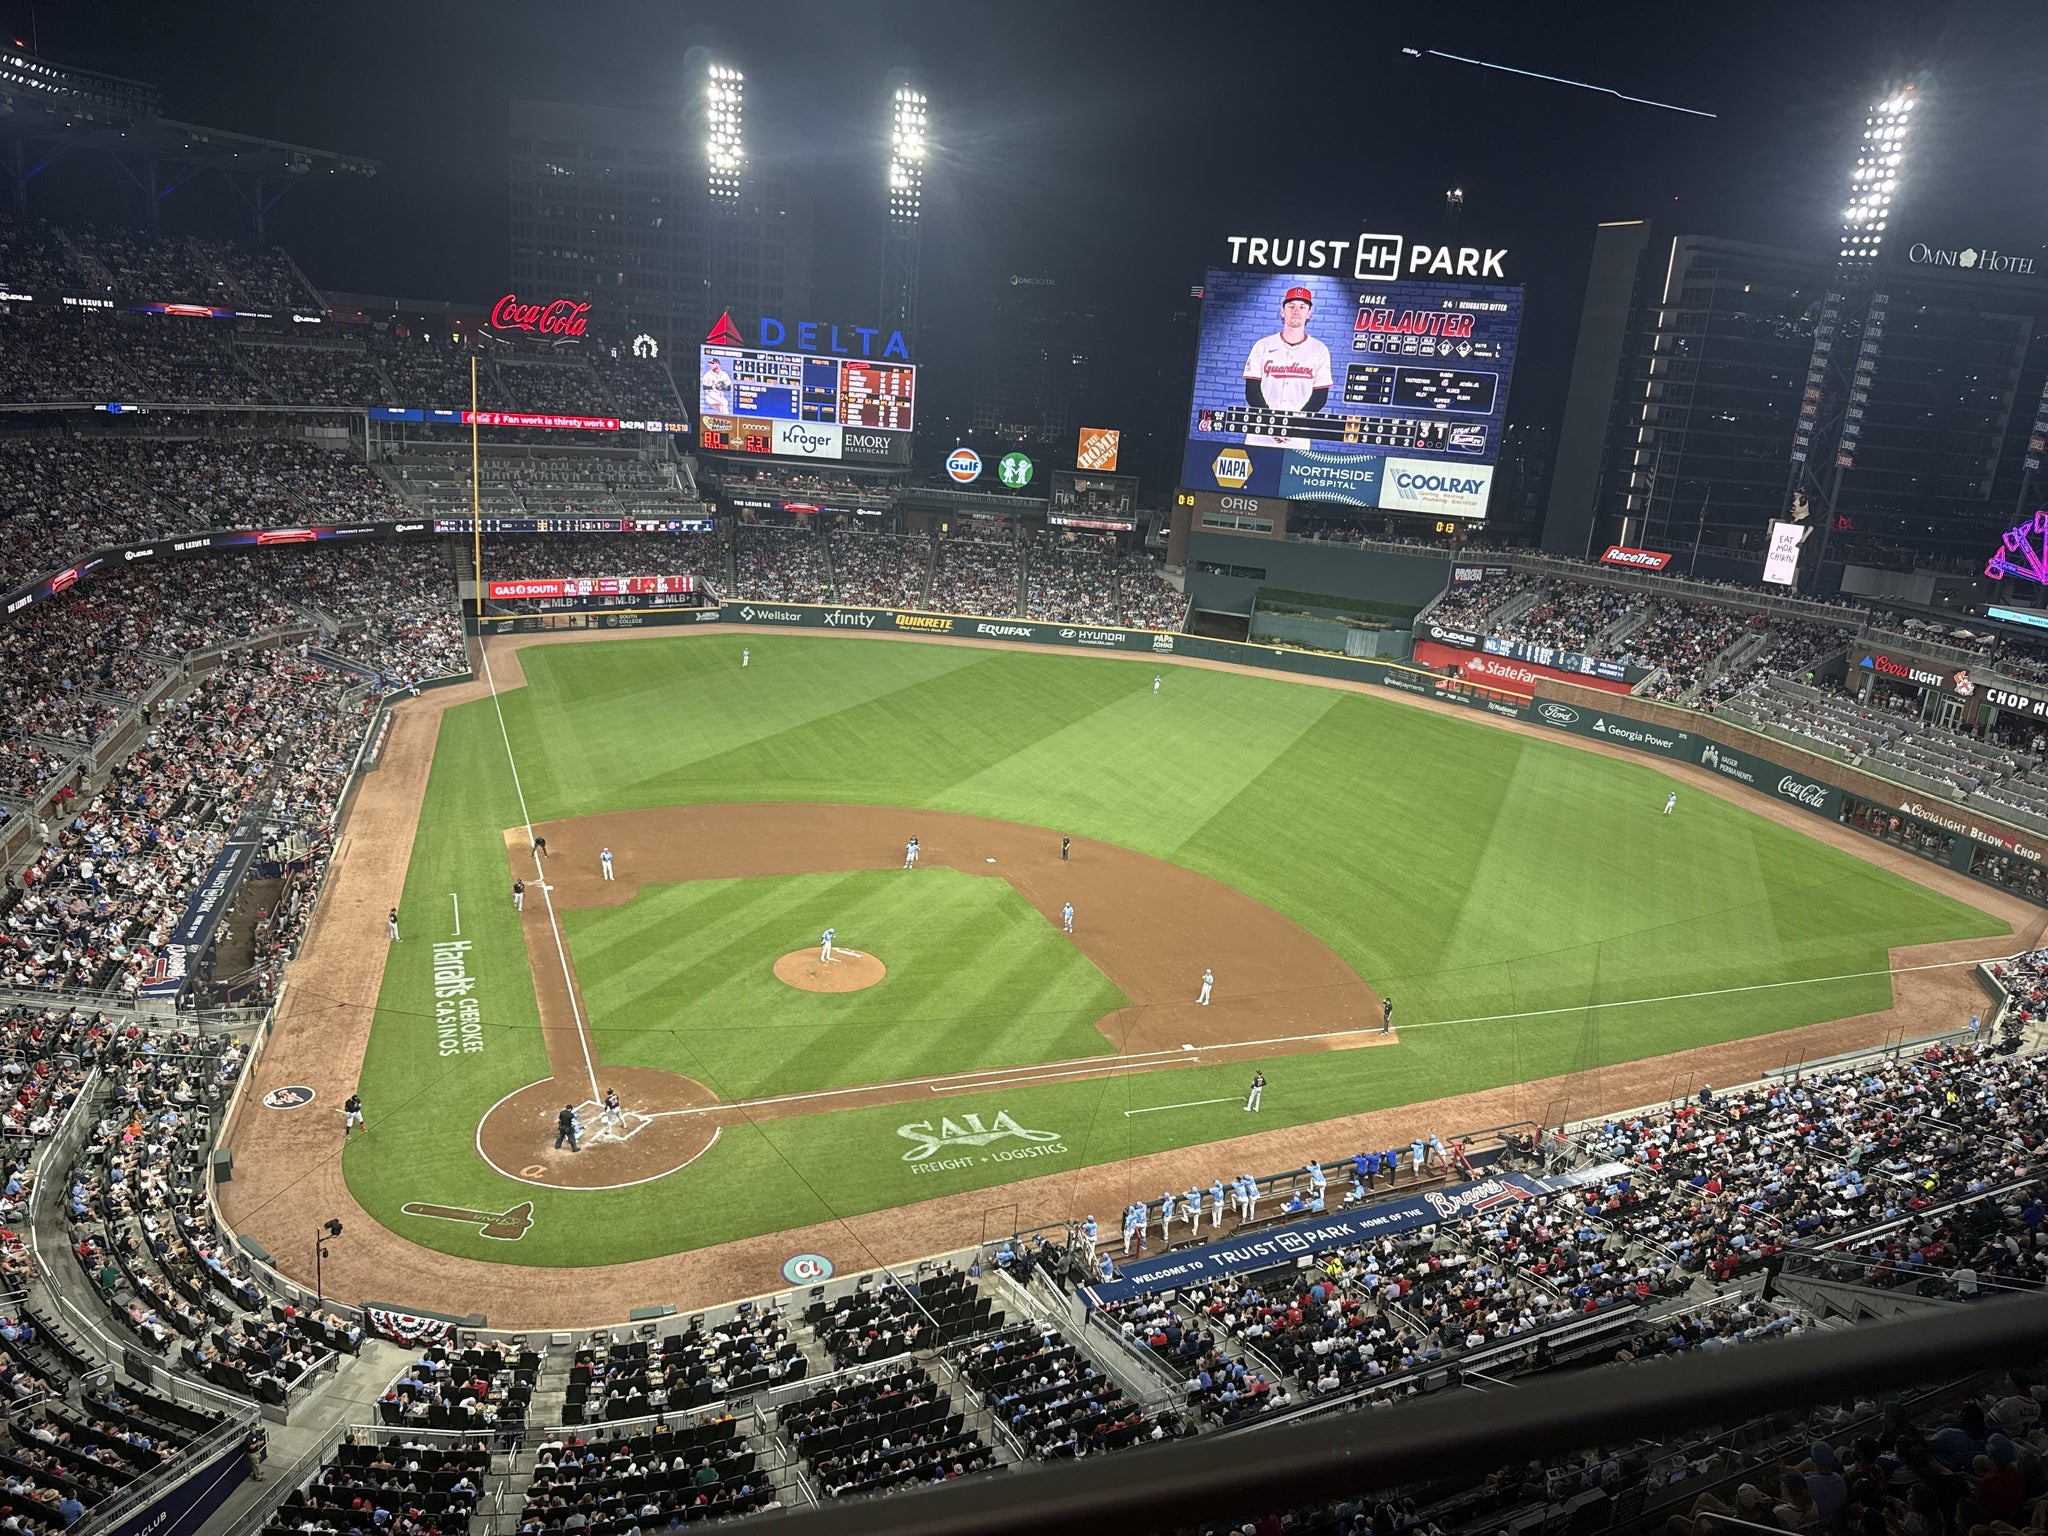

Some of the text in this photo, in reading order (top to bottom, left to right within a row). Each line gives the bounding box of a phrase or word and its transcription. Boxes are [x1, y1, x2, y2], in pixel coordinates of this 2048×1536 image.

[1227, 236, 1509, 278] TRUIST PARK
[63, 297, 78, 305] THE
[79, 298, 102, 307] LEXUS
[1359, 295, 1387, 305] CHASE
[1443, 301, 1453, 309] 24
[491, 294, 593, 337] Coca-Cola
[1354, 308, 1476, 338] DELAUTER
[760, 317, 910, 359] DELTA
[1263, 360, 1314, 379] Guardians
[503, 415, 606, 428] Fan work is thirsty work
[634, 421, 645, 430] PM
[1420, 426, 1429, 437] 3
[1437, 427, 1442, 439] 1
[783, 424, 831, 454] Kroger
[845, 434, 892, 449] EMORY
[845, 446, 889, 455] HEALTHCARE
[1079, 430, 1118, 467] HOME
[1093, 447, 1117, 469] DEPOT
[950, 459, 979, 472] Gulf
[1218, 459, 1247, 478] NAPA
[1290, 465, 1374, 483] NORTHSIDE
[1303, 478, 1357, 490] HOSPITAL
[1397, 473, 1486, 494] COOLRAY
[1221, 497, 1258, 511] ORIS
[1779, 535, 1794, 544] EAT
[174, 543, 185, 551] THE
[1776, 544, 1792, 554] MOR
[1607, 549, 1662, 568] RaceTrac
[1770, 552, 1794, 564] CHIKIN
[1454, 573, 1482, 582] VISION
[495, 585, 558, 596] GAS SOUTH
[564, 582, 577, 593] AL
[552, 598, 579, 608] MLB+
[615, 595, 641, 606] MB+
[665, 593, 692, 604] MLB+
[757, 610, 802, 622] Wellstar
[823, 610, 876, 628] xfinity
[895, 614, 953, 629] QUIKRETE
[977, 623, 1032, 637] EQUIFAX
[1079, 630, 1126, 642] HYUNDAI
[1443, 631, 1476, 643] LEXUS
[1153, 641, 1174, 649] JOHNS
[1154, 635, 1174, 643] PAPA
[1485, 640, 1498, 651] NL
[1874, 655, 1944, 687] Coors LIGHT
[1986, 689, 2029, 710] CHOP
[1495, 704, 1518, 715] National
[1544, 704, 1572, 722] Ford
[1608, 724, 1673, 749] Georgia Power
[1720, 755, 1738, 767] KAISER
[1719, 763, 1754, 783] PERMANENTE
[1777, 775, 1830, 809] Coca-Cola
[1911, 802, 1939, 824] Coors
[1939, 817, 1967, 835] LIGHT
[1970, 826, 2003, 848] BELOW
[2013, 843, 2042, 862] CHOP
[211, 869, 233, 889] TRUIST
[436, 1000, 460, 1057] CASINOS
[458, 998, 484, 1054] CHEROKEE
[896, 1110, 1061, 1162] SAIA
[910, 1156, 975, 1175] FREIGHT
[991, 1142, 1068, 1163] LOGISTICS
[1424, 1178, 1503, 1218] Braves
[1132, 1208, 1423, 1285] WELCOME TO TRUIST PARK HOME OF THE
[141, 1511, 168, 1536] CLUB
